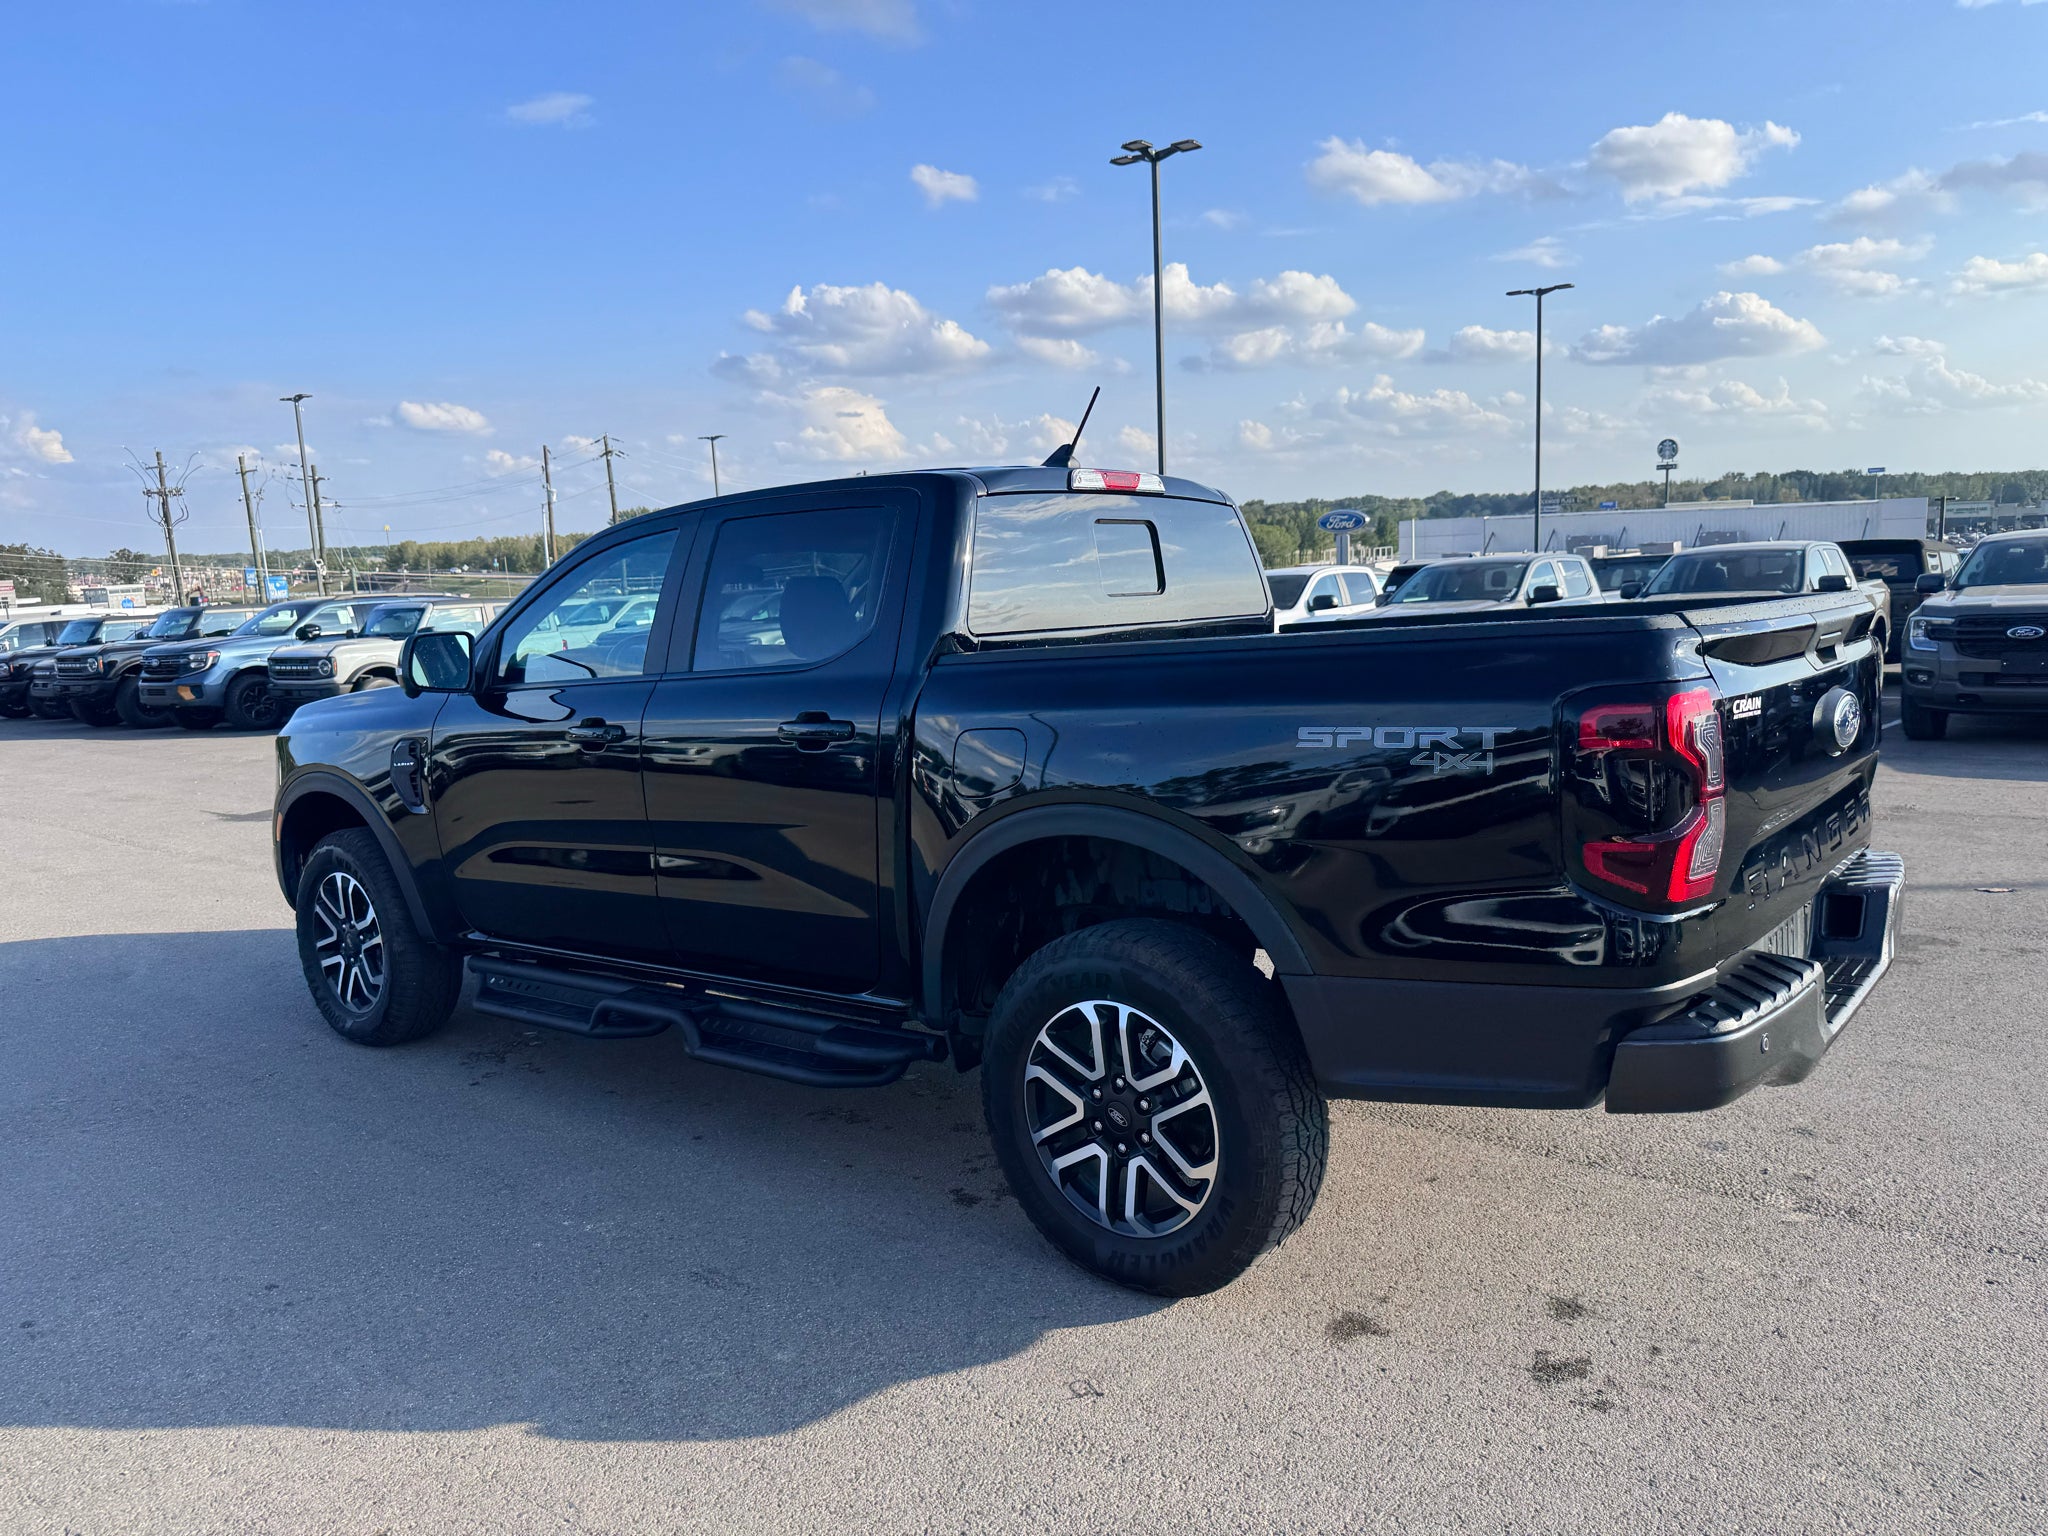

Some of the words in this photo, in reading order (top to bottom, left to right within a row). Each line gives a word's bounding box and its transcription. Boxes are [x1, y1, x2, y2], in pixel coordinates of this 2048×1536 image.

[1326, 515, 1357, 529] Ford
[1732, 696, 1762, 714] CRAIN
[1296, 726, 1518, 750] SPORT
[1743, 787, 1871, 911] RANGER
